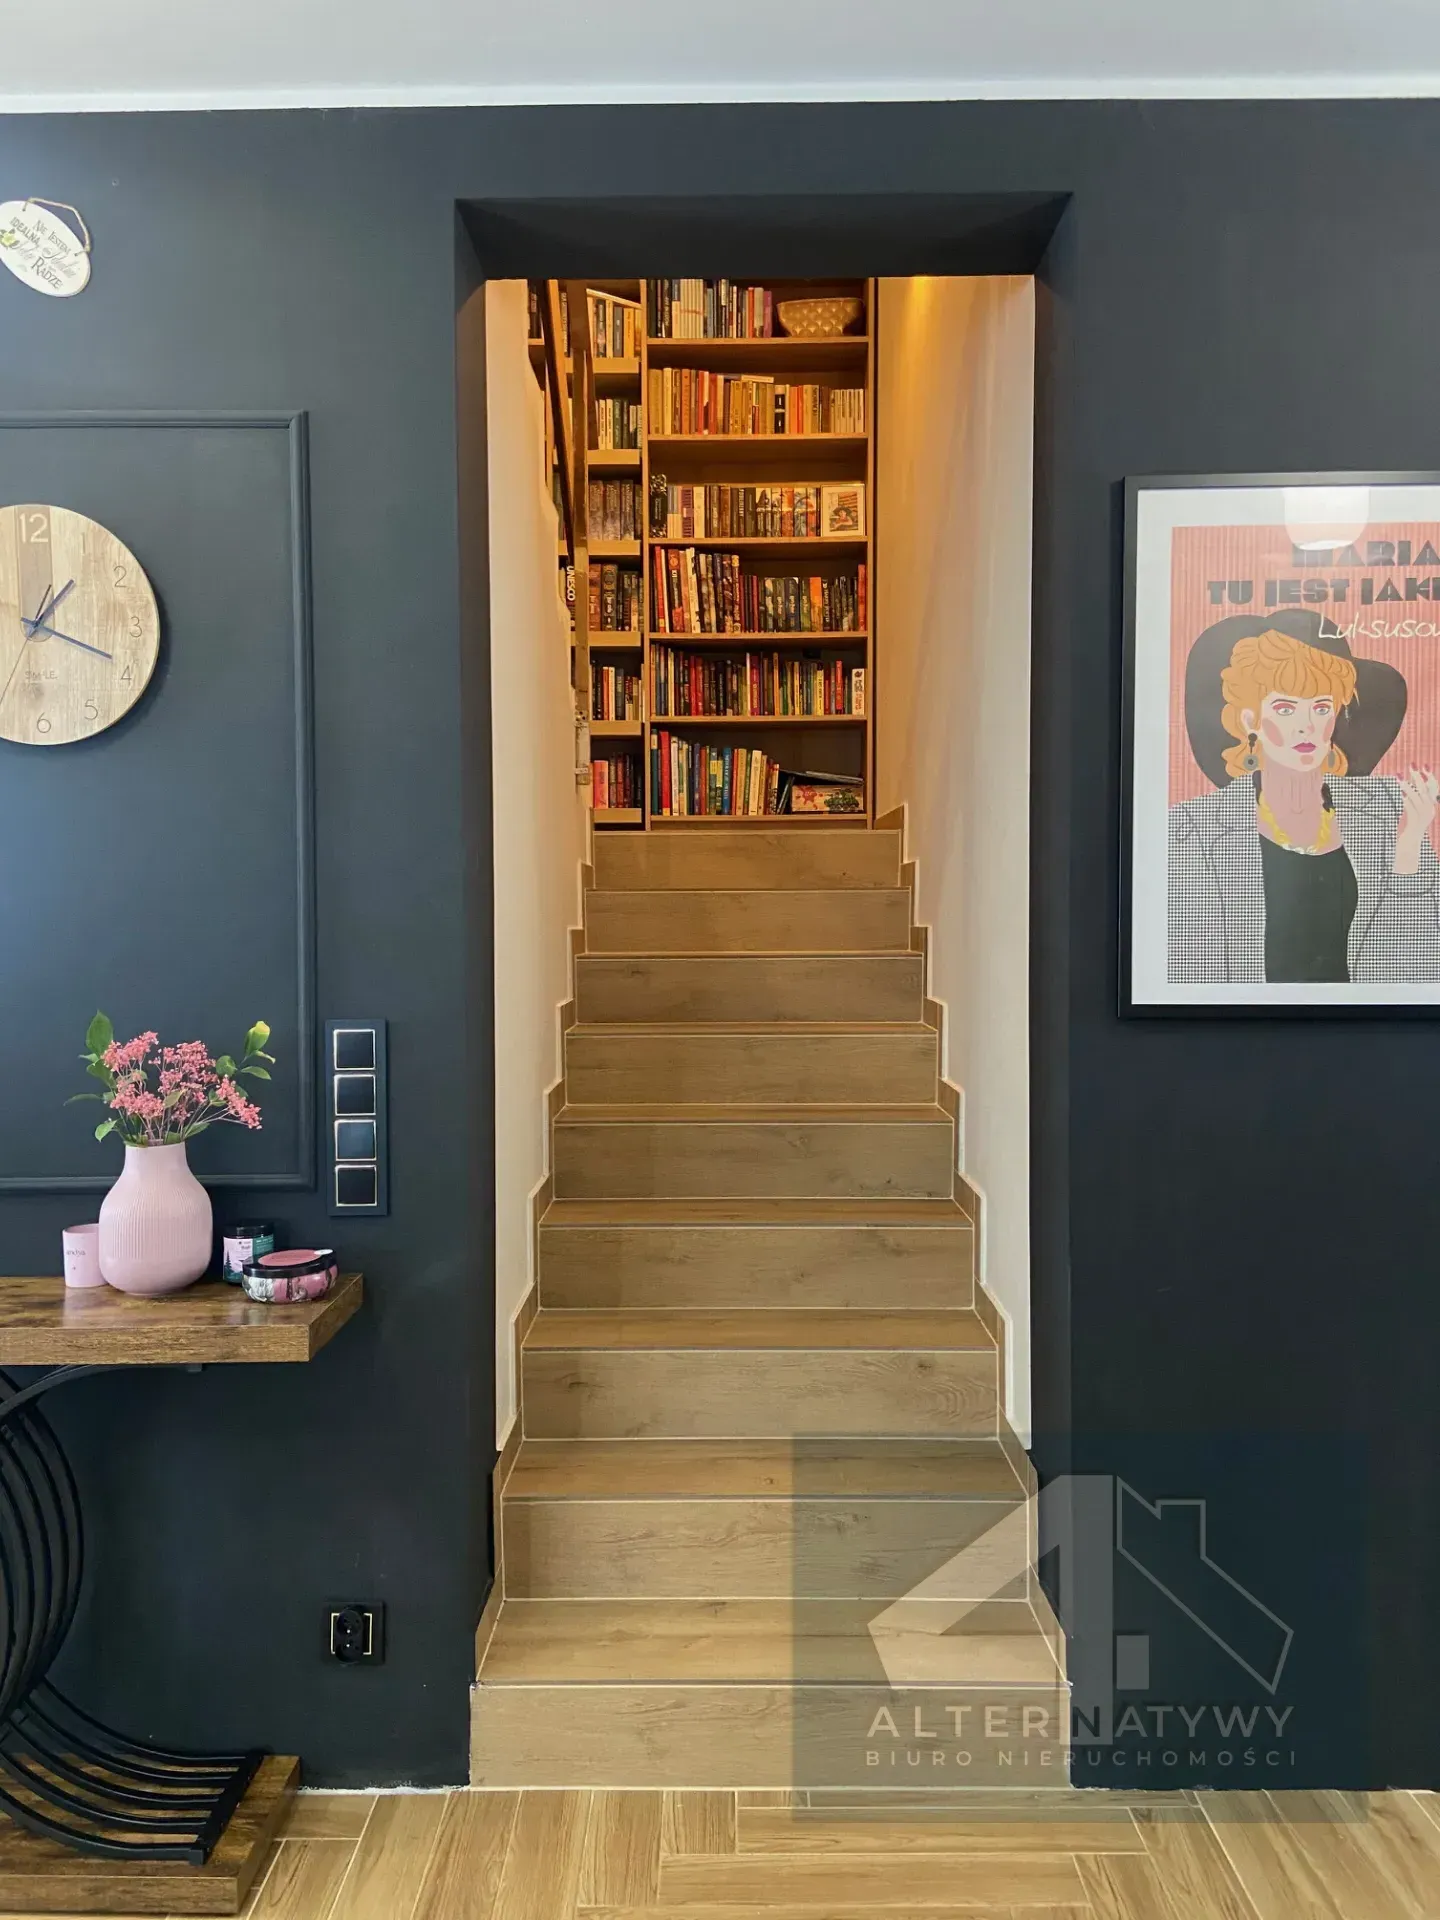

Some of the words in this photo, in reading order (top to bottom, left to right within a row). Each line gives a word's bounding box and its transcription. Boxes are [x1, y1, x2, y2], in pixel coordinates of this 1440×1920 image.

[19, 513, 48, 543] 12
[113, 566, 127, 588] 2
[566, 565, 576, 601] UNESCO
[1207, 580, 1253, 605] TU
[1264, 578, 1350, 607] JEST
[128, 616, 143, 638] 3
[120, 665, 132, 682] 4
[84, 699, 99, 720] 5
[36, 712, 51, 733] 6
